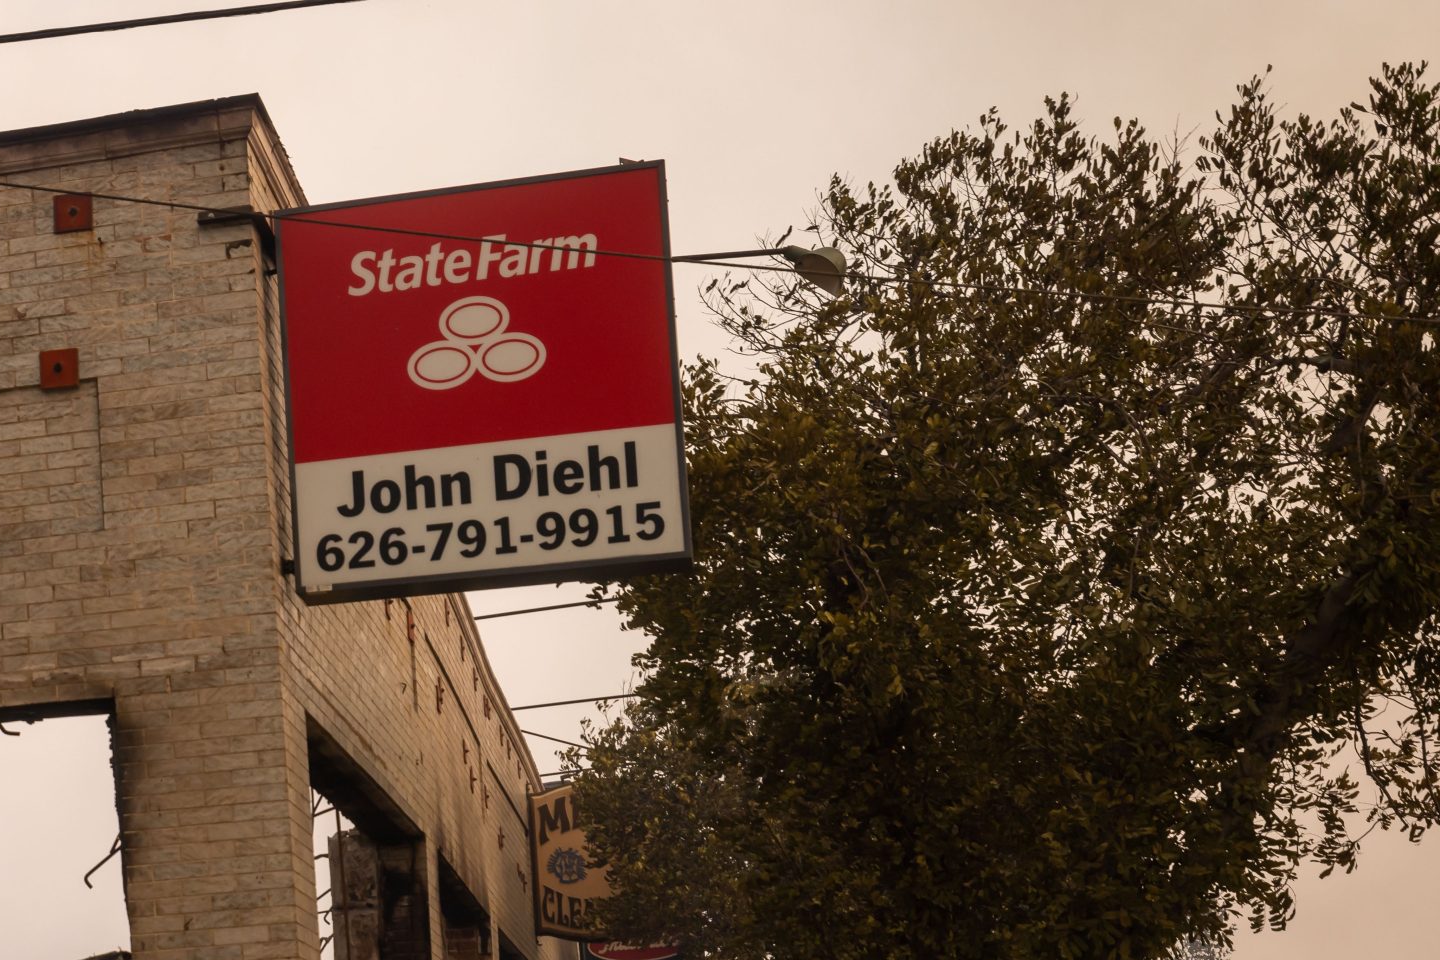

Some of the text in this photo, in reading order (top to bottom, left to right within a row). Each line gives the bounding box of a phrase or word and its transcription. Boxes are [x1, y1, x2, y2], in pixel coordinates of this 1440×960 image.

[336, 441, 639, 518] John Diehl
[316, 501, 665, 572] 626-791-9915
